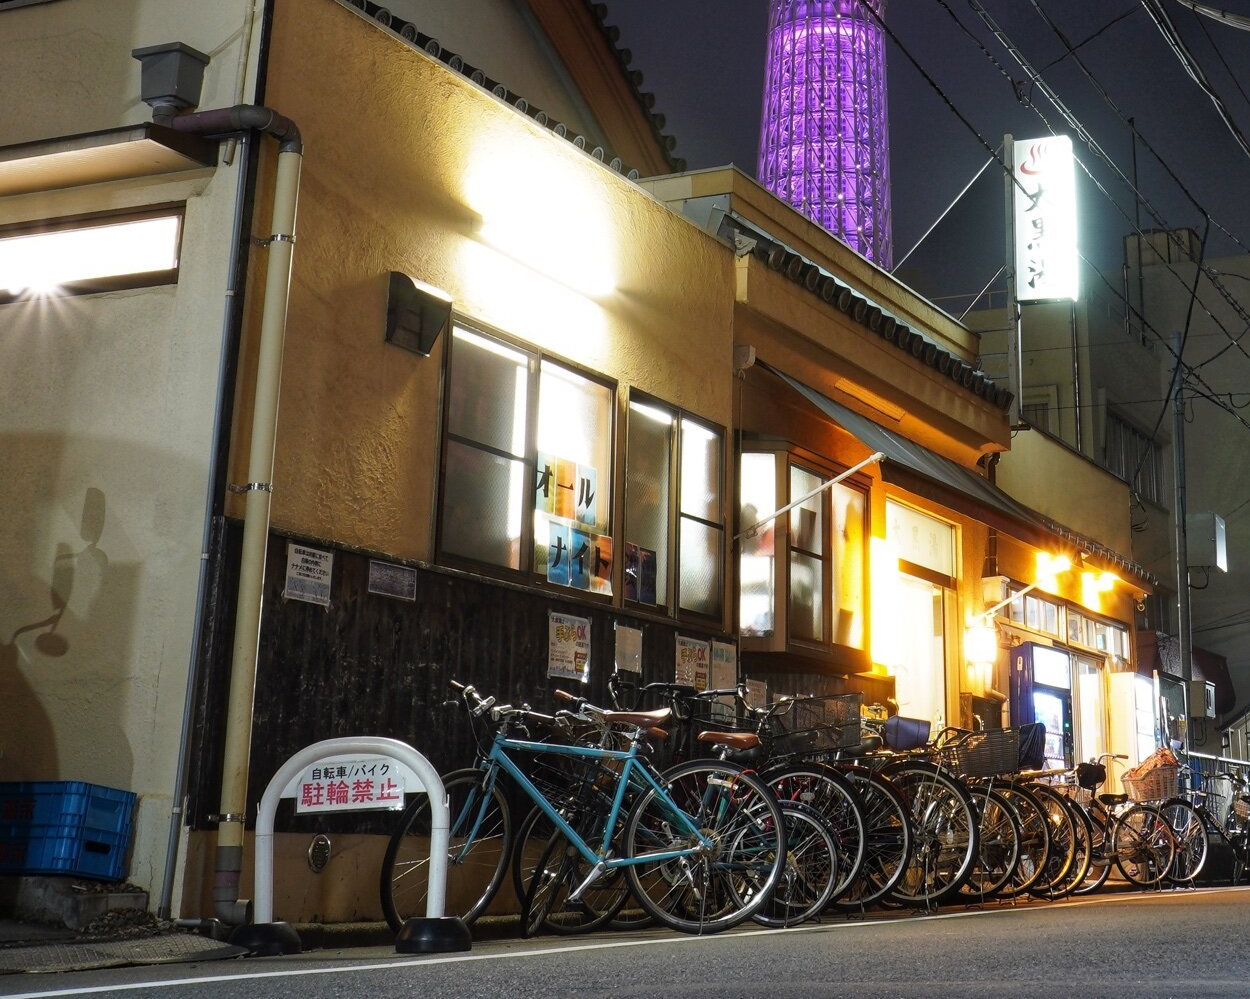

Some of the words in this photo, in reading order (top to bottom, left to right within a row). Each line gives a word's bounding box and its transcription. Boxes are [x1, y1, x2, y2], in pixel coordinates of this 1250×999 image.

[536, 465, 595, 509] オール
[551, 536, 609, 577] ナイト
[312, 763, 390, 780] 自転車/バイク
[301, 778, 400, 807] 駐輪禁止
